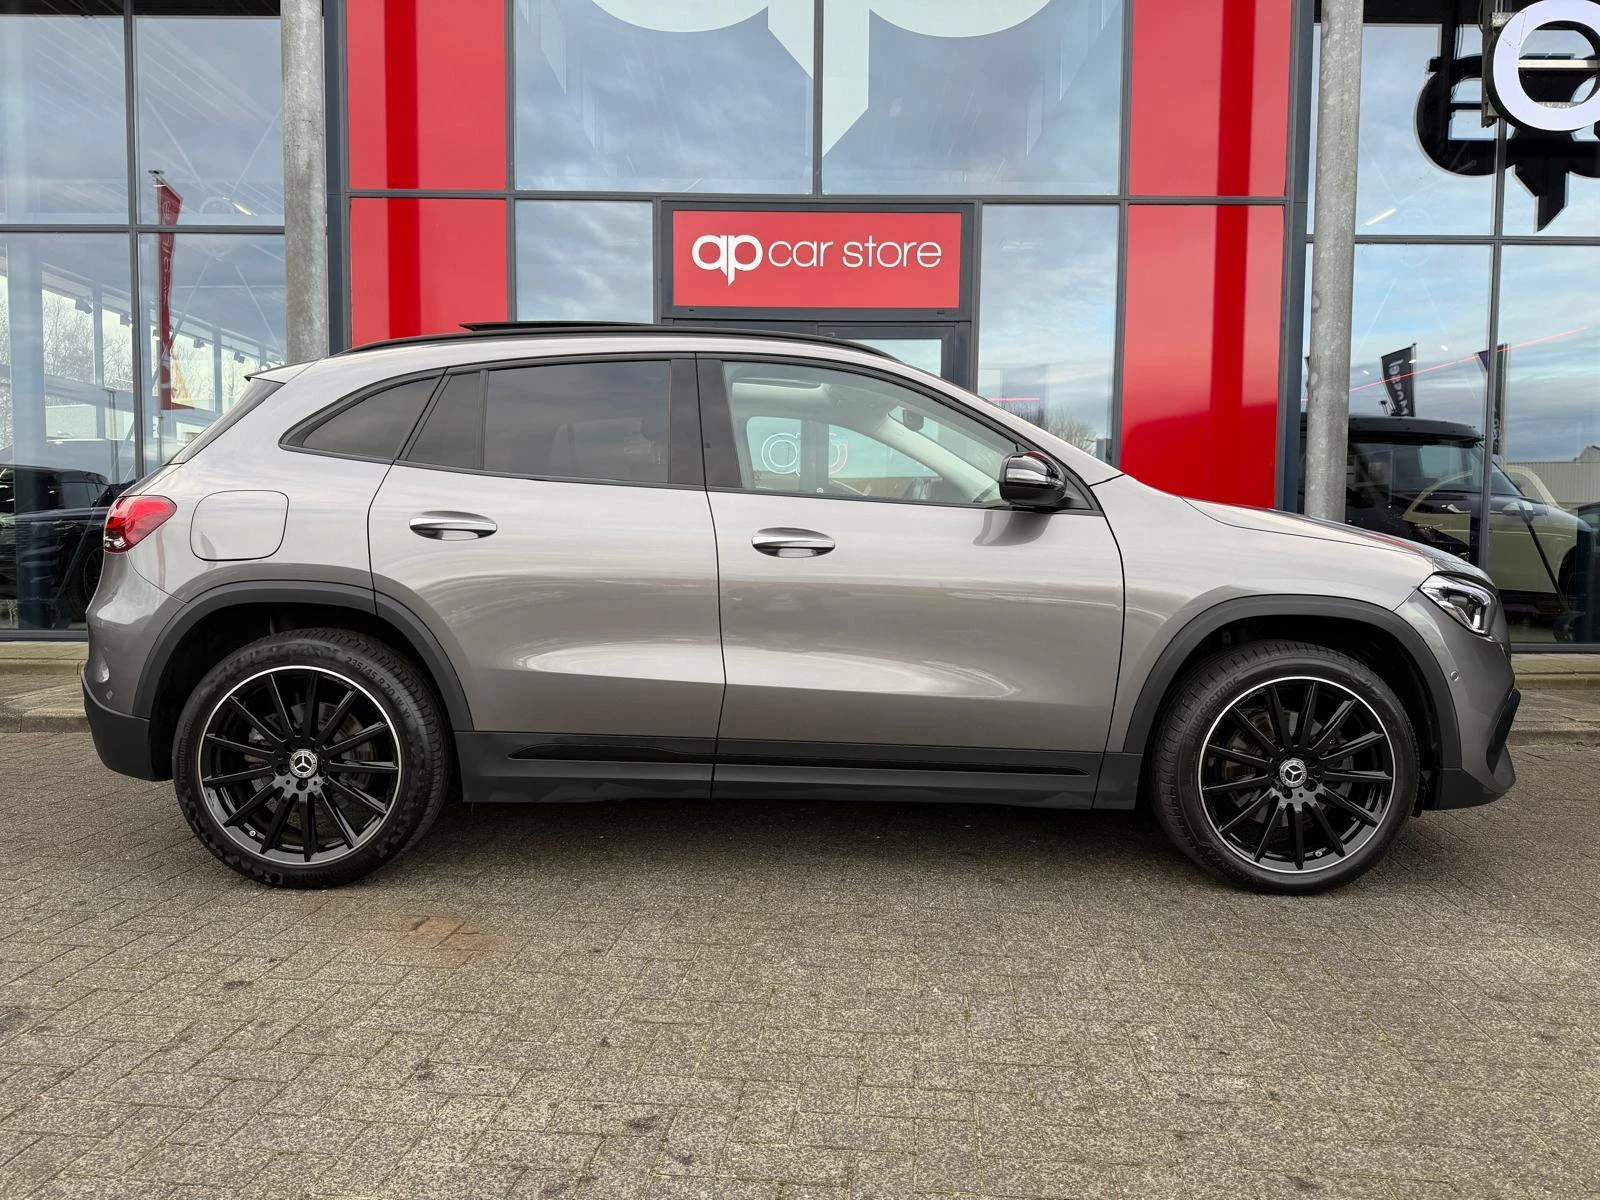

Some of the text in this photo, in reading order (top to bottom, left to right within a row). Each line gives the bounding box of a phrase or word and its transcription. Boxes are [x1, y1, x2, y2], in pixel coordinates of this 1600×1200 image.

[692, 234, 942, 287] ap car store
[345, 656, 378, 680] 235/45
